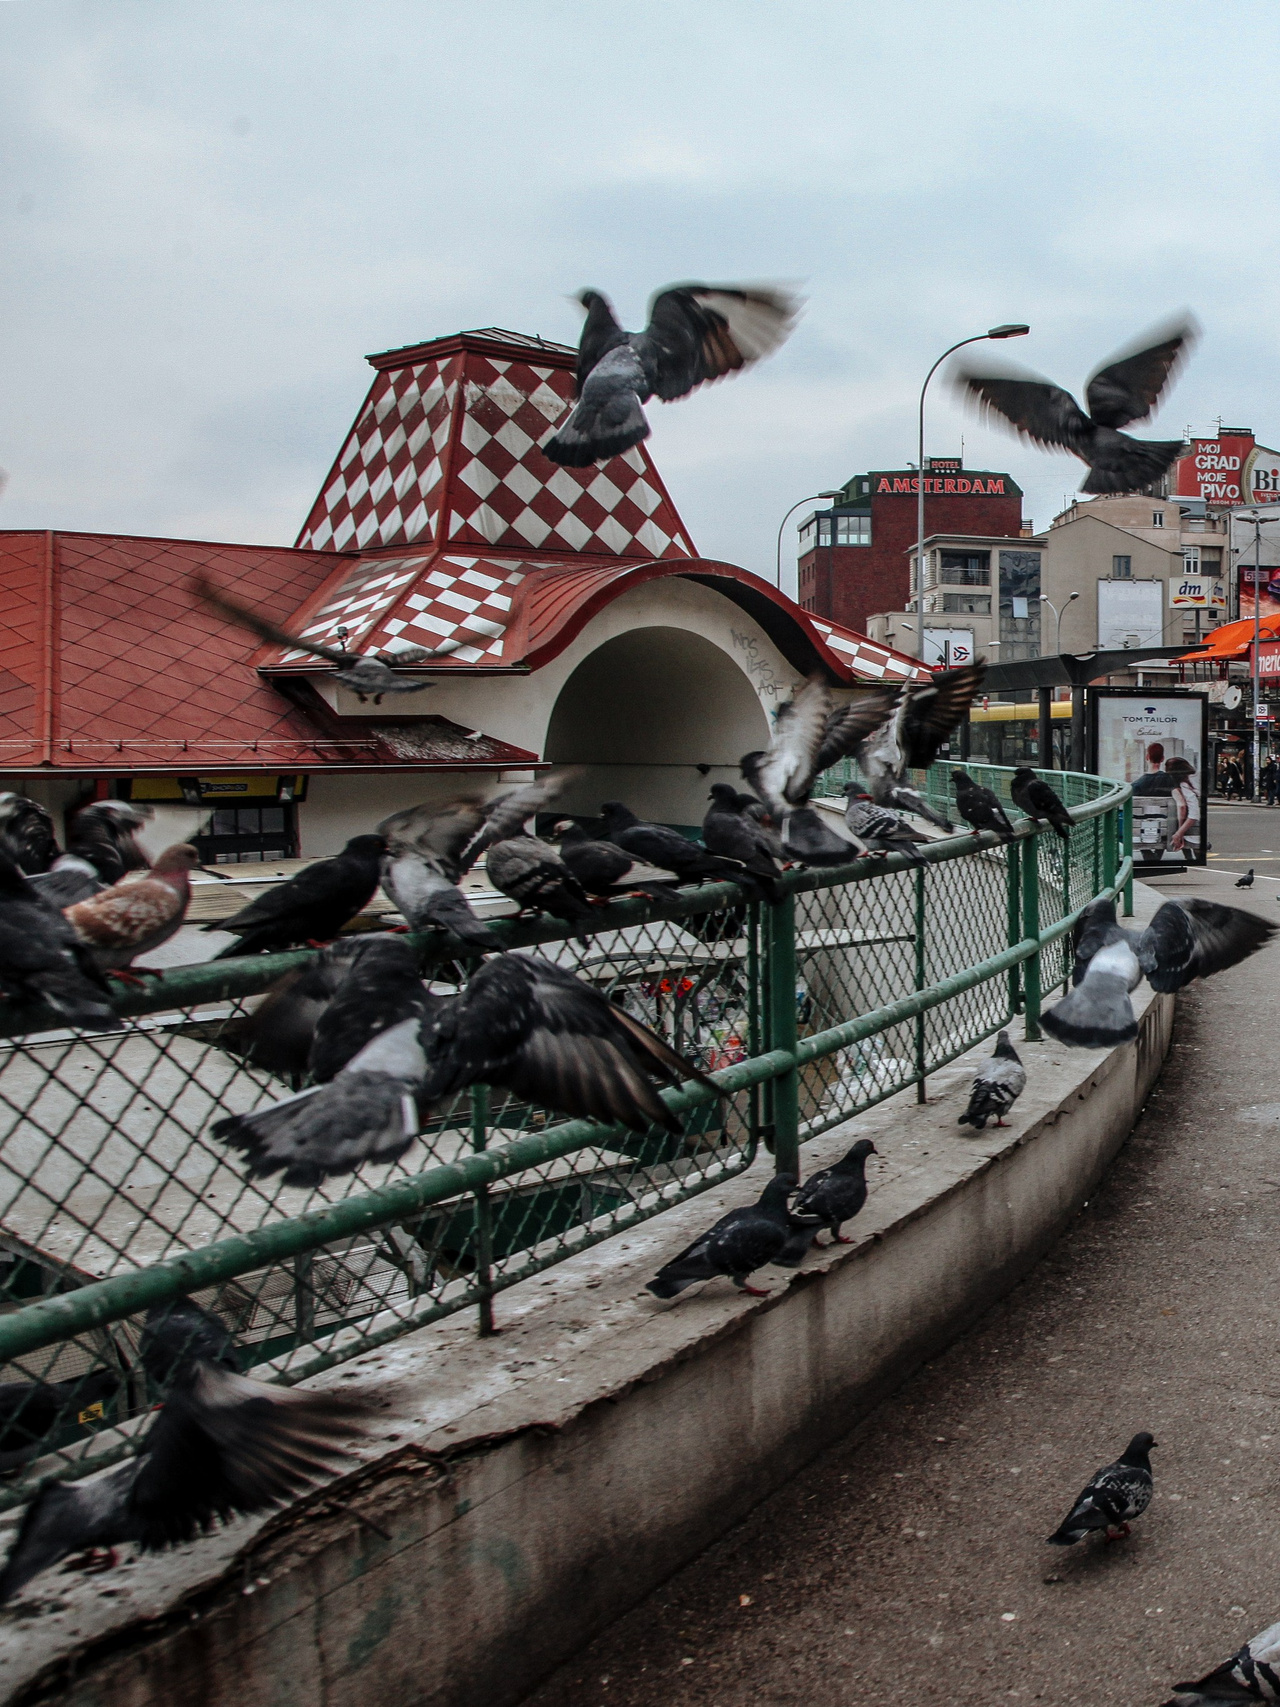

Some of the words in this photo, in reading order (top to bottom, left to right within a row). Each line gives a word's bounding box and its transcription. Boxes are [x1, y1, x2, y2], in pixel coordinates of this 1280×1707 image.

[1198, 443, 1220, 454] MOJ
[931, 460, 960, 469] HOTEL
[1195, 455, 1240, 471] GRAD
[1197, 472, 1227, 483] MOJE
[877, 478, 1005, 494] AMSTERDAM
[1200, 483, 1240, 499] PIVO
[1246, 571, 1253, 581] 5
[1179, 581, 1201, 595] dm
